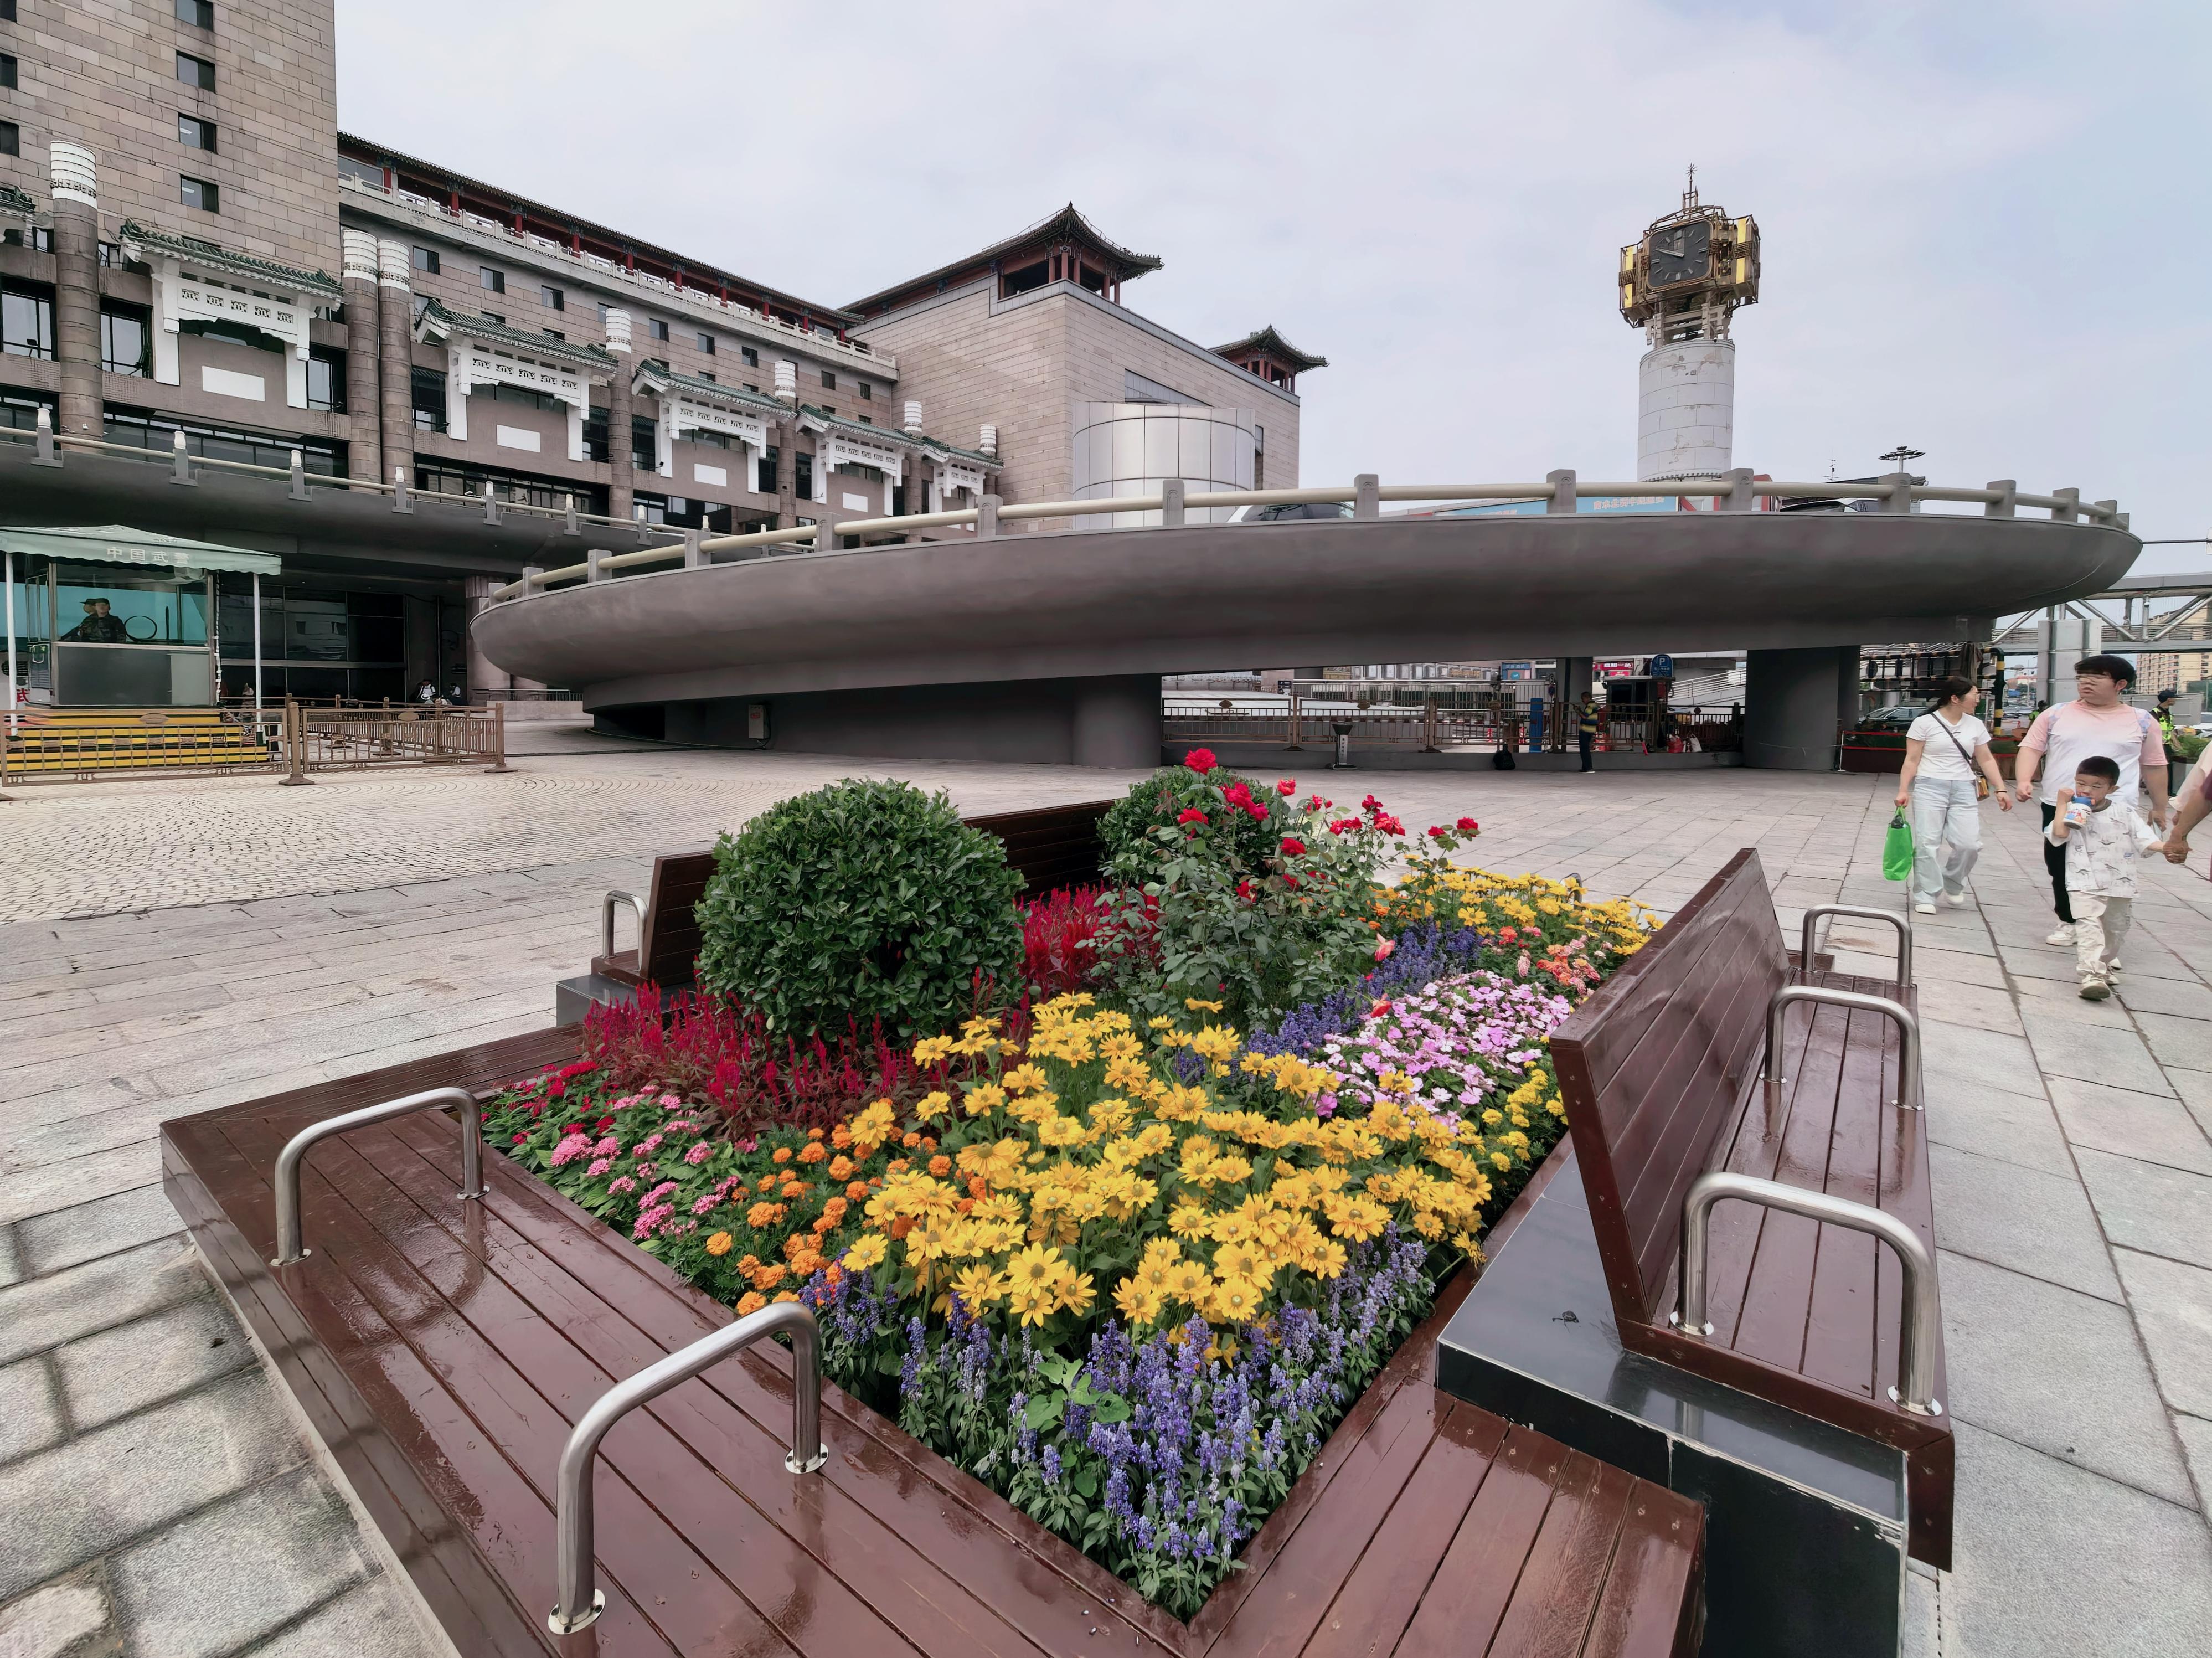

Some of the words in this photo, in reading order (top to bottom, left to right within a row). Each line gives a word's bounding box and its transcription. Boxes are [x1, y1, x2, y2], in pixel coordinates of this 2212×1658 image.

[106, 547, 190, 564] 中国武警
[1659, 657, 1666, 666] P
